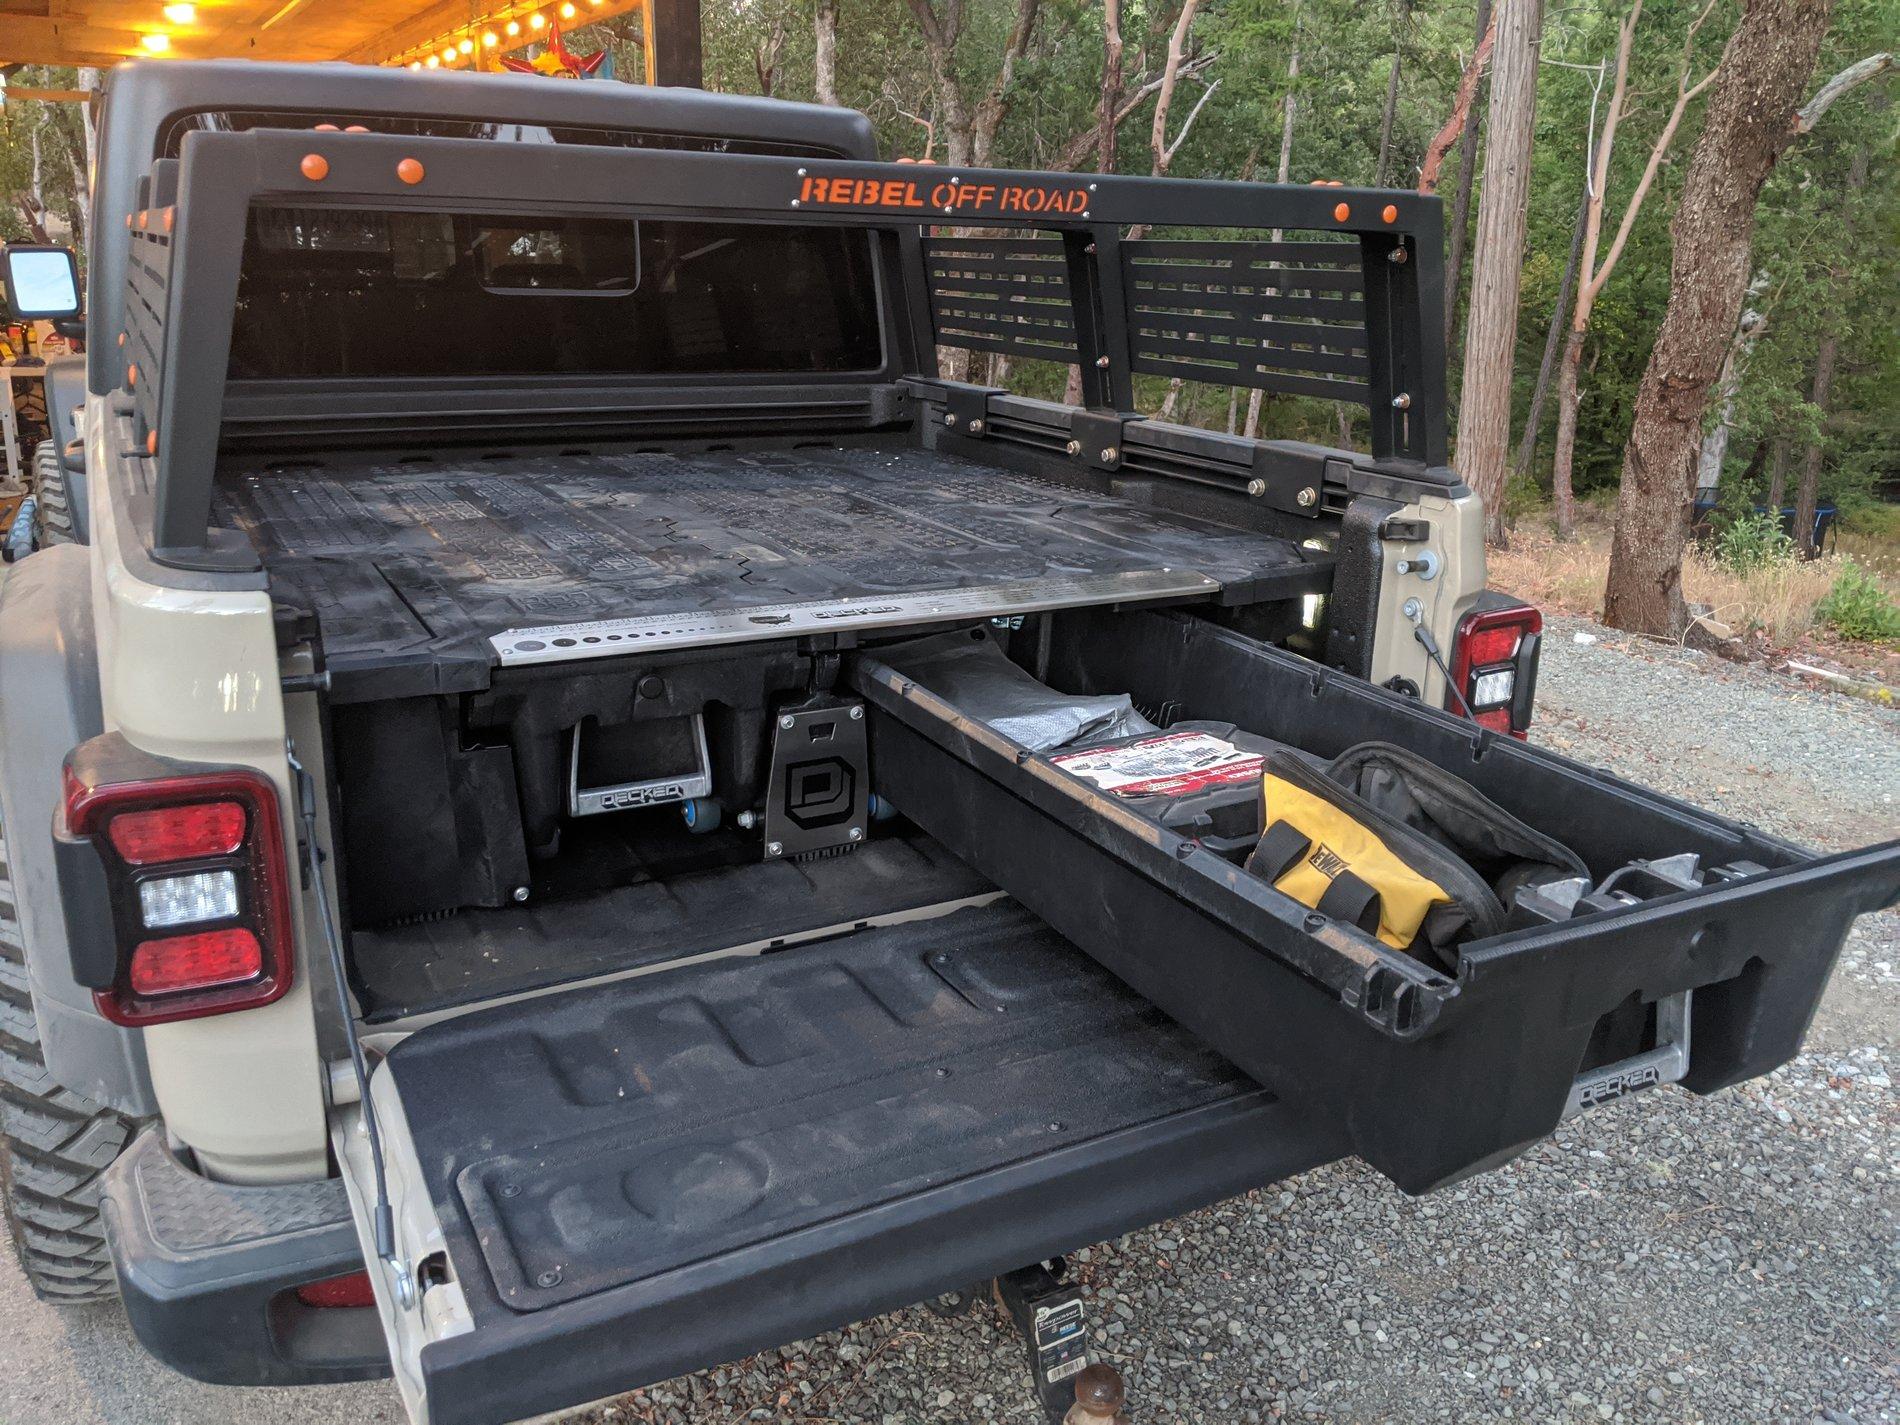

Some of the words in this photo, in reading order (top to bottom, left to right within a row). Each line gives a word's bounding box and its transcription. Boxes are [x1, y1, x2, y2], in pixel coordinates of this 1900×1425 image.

[800, 177, 924, 207] REBEL
[931, 182, 995, 210] OFF
[1000, 186, 1089, 214] ROAD
[600, 784, 685, 809] DECKED
[1579, 1066, 1660, 1109] DECKED
